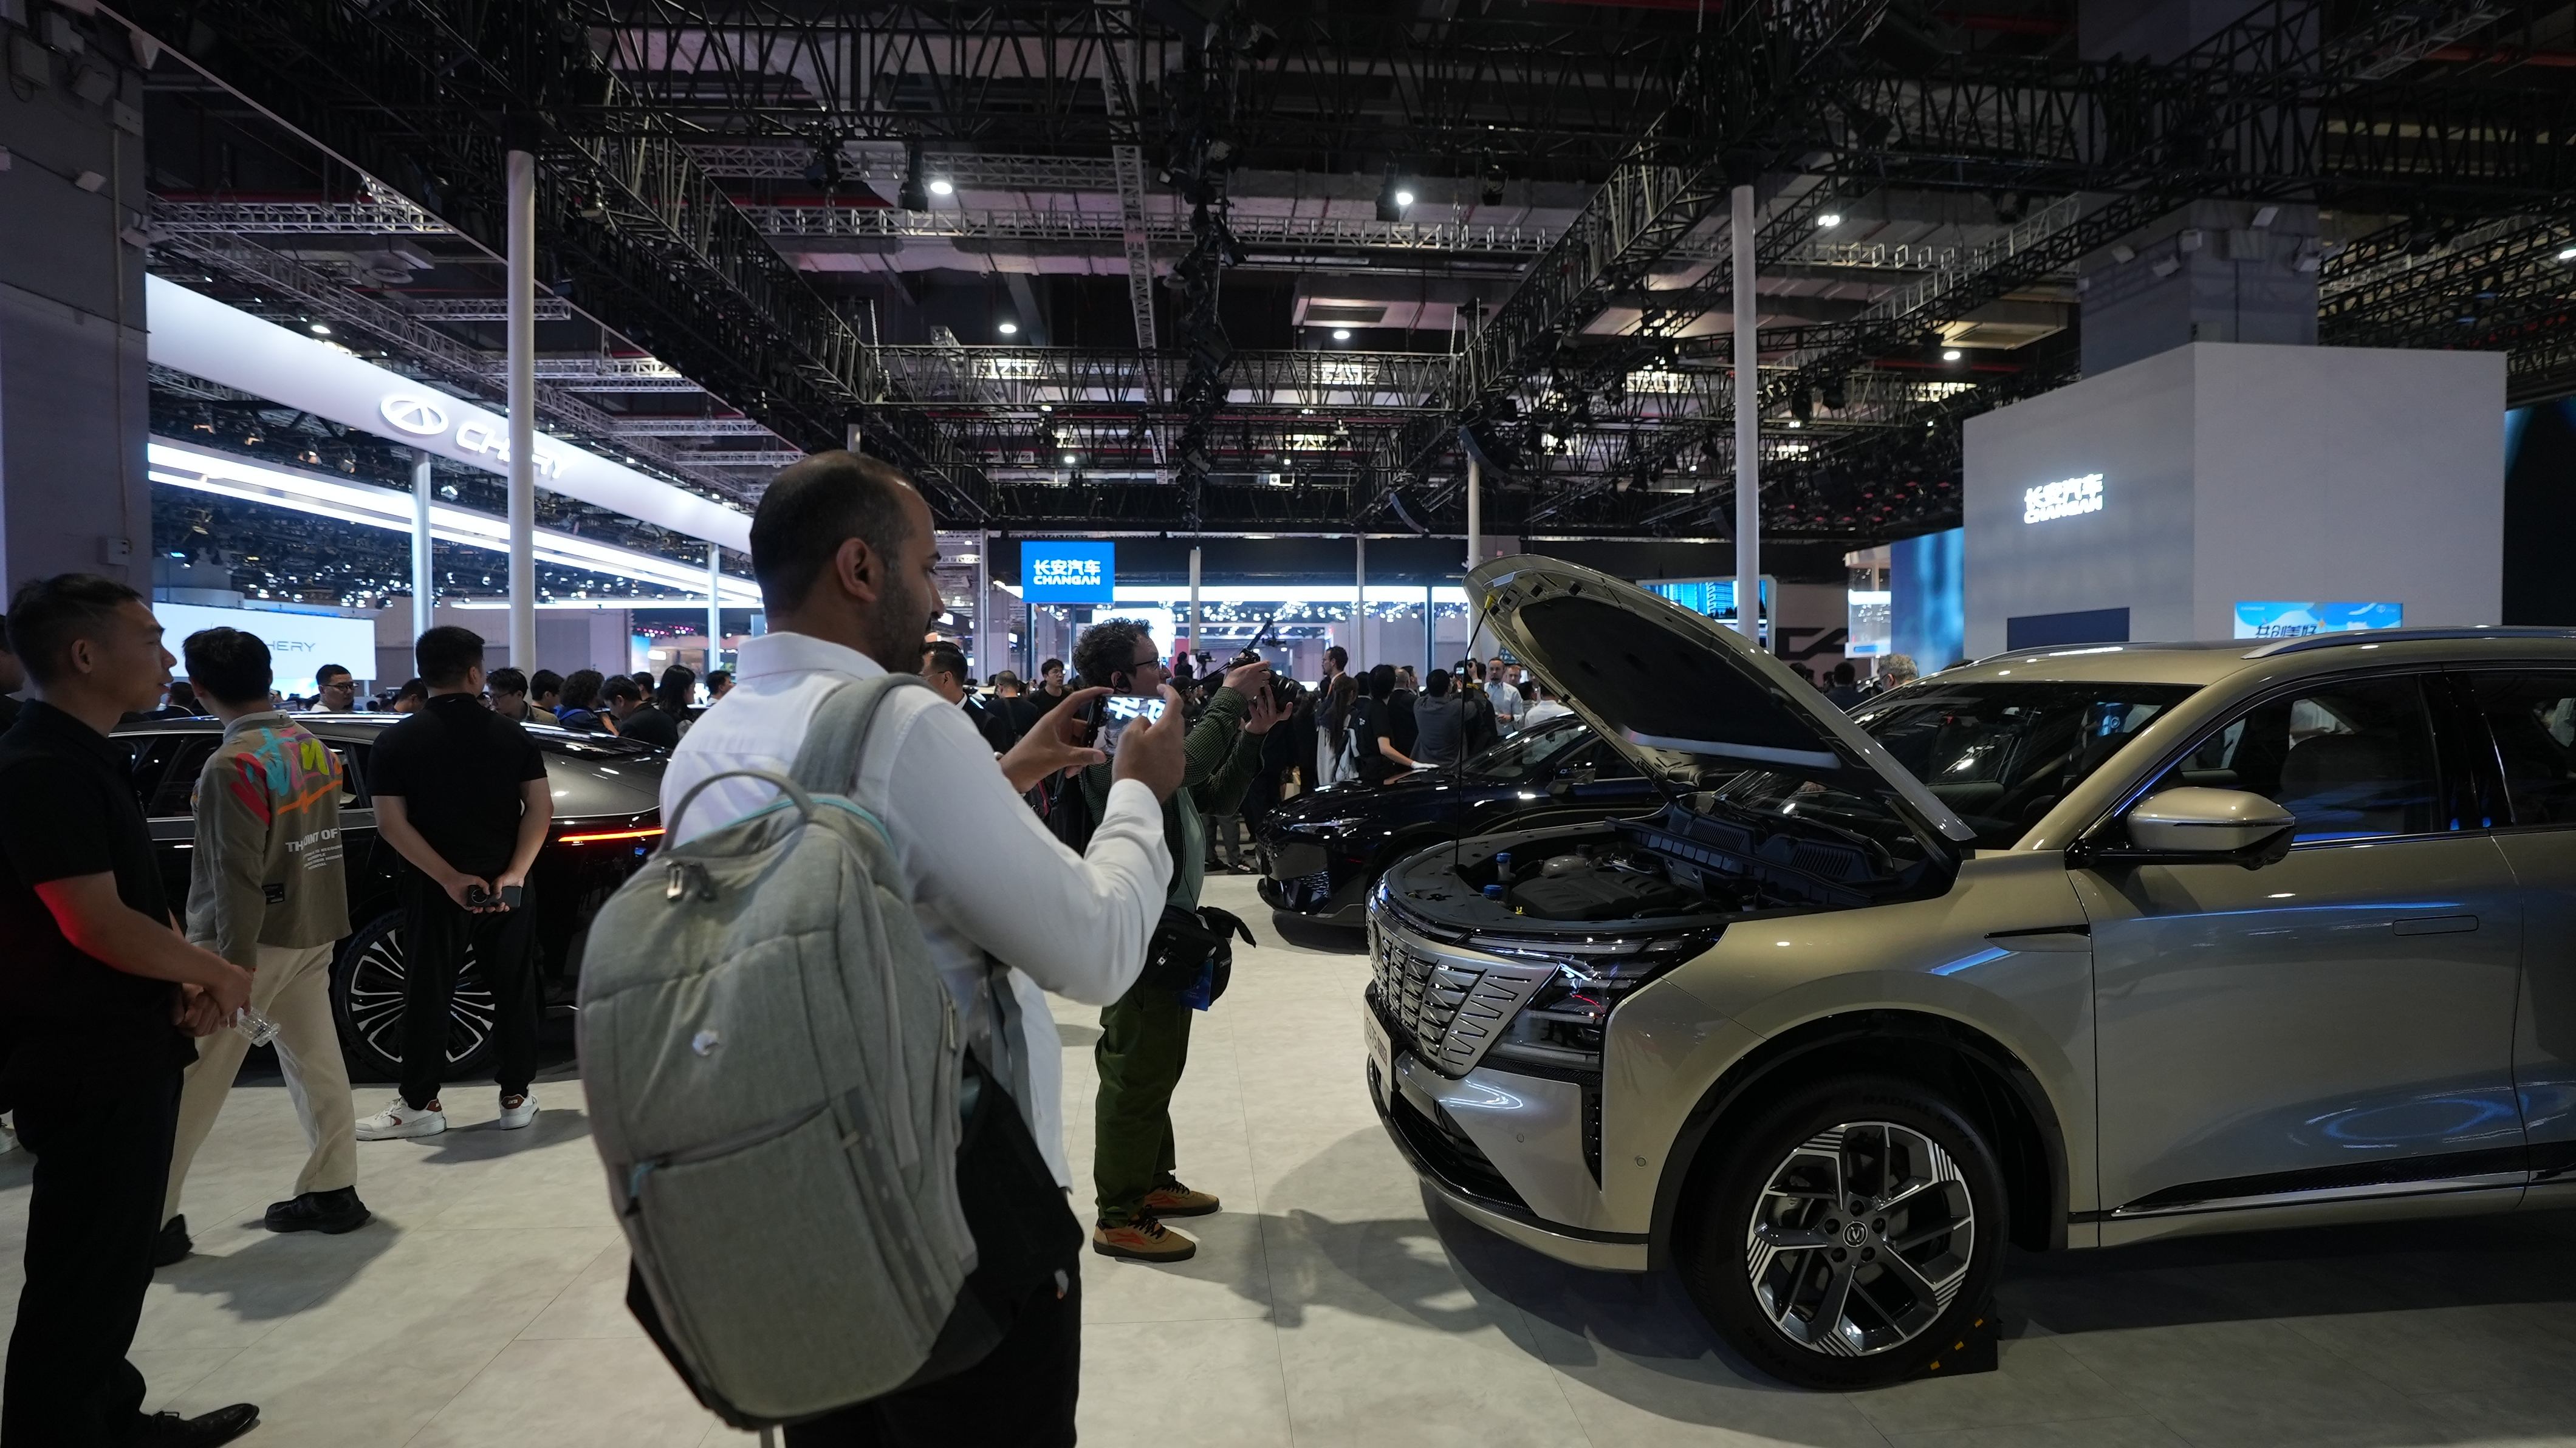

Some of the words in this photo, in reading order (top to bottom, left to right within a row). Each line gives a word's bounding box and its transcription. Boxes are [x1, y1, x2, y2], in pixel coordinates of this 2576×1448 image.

[456, 422, 570, 479] CHRY
[1033, 559, 1101, 576] 长安汽车
[1033, 575, 1101, 585] CHANGAN
[267, 640, 315, 652] HERY
[285, 838, 304, 852] TH
[303, 831, 320, 846] OINT
[320, 828, 338, 840] OF
[1366, 1017, 1377, 1050] CS75
